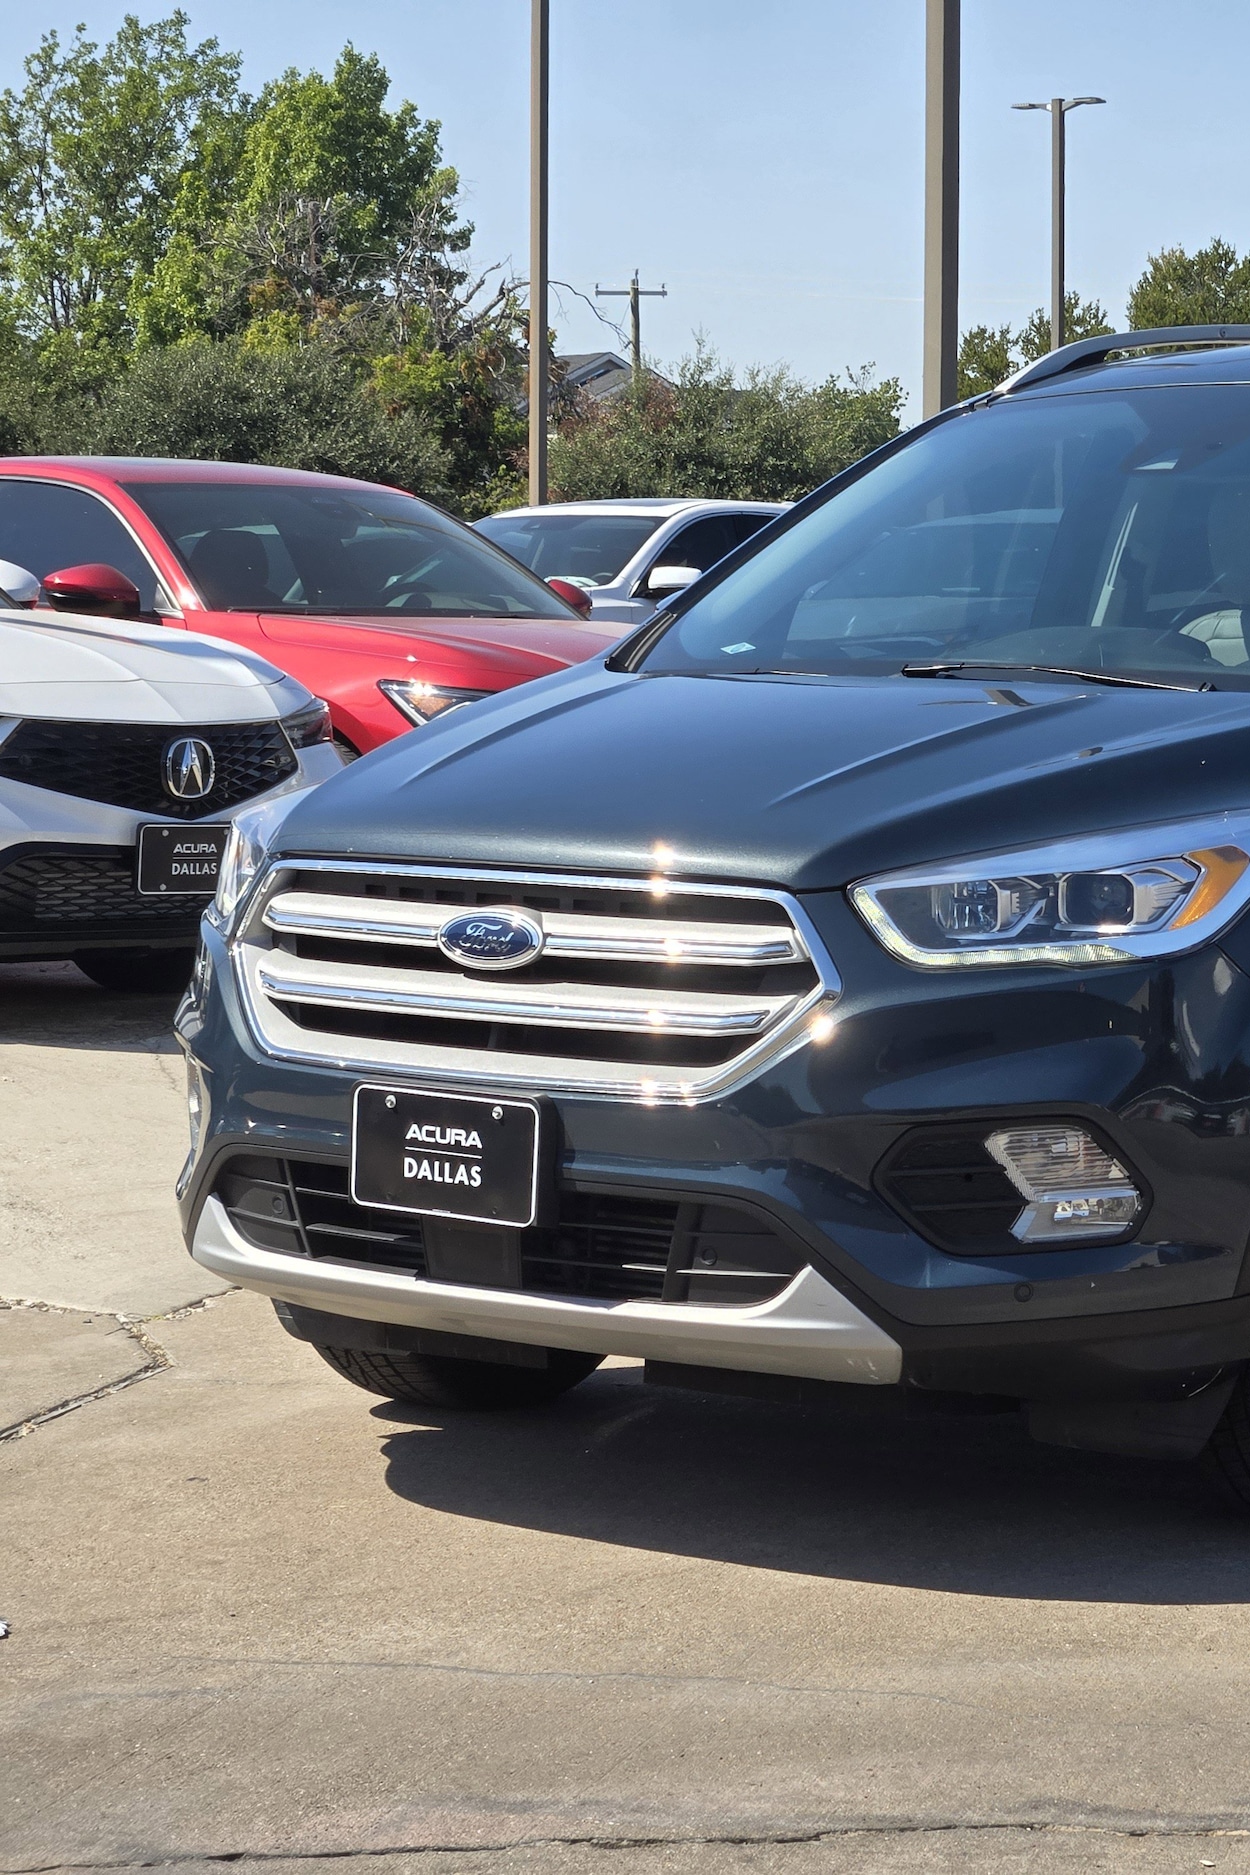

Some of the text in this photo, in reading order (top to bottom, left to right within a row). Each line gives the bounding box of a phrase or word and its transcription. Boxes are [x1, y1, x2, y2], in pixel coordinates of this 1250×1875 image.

[173, 843, 218, 854] ACURA
[171, 862, 218, 876] DALLAS
[458, 922, 515, 954] Ford
[405, 1122, 484, 1150] ACURA
[402, 1156, 483, 1189] DALLAS
